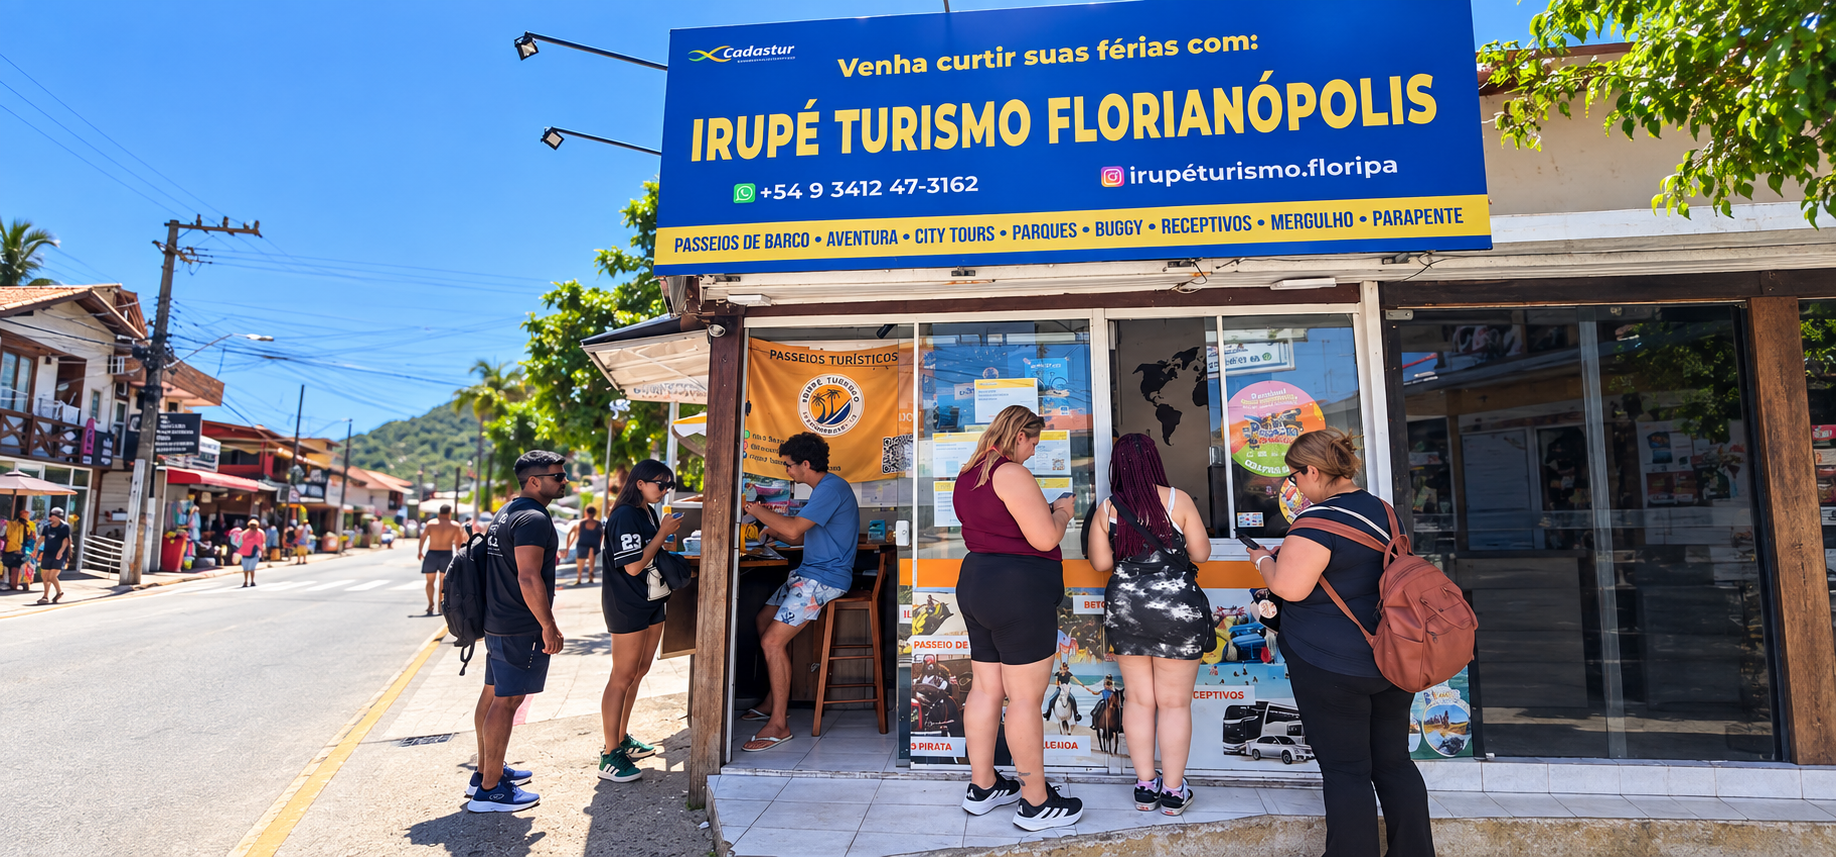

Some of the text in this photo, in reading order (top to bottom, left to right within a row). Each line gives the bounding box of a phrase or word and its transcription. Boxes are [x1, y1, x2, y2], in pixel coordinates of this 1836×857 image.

[723, 45, 795, 59] Cadastur
[837, 34, 1259, 78] Venha curtir suas férias com:
[691, 70, 1438, 162] IRUPÉ TURISMO FLORIANÓPOLIS
[1129, 156, 1399, 187] irupéturismo.floripa
[760, 175, 980, 200] +54 9 3412 47-3162
[674, 207, 1464, 253] PASSEIOS DE BARCO AVENTURA CITY TOURS PARQUES BUGGY RECEPTIVOS MERGULHO PARAPENTE
[769, 349, 899, 366] PASSEIOS TURÍSTICOS
[620, 533, 642, 551] 23
[913, 640, 969, 650] PASSEIO DE
[918, 742, 953, 751] PIRATA
